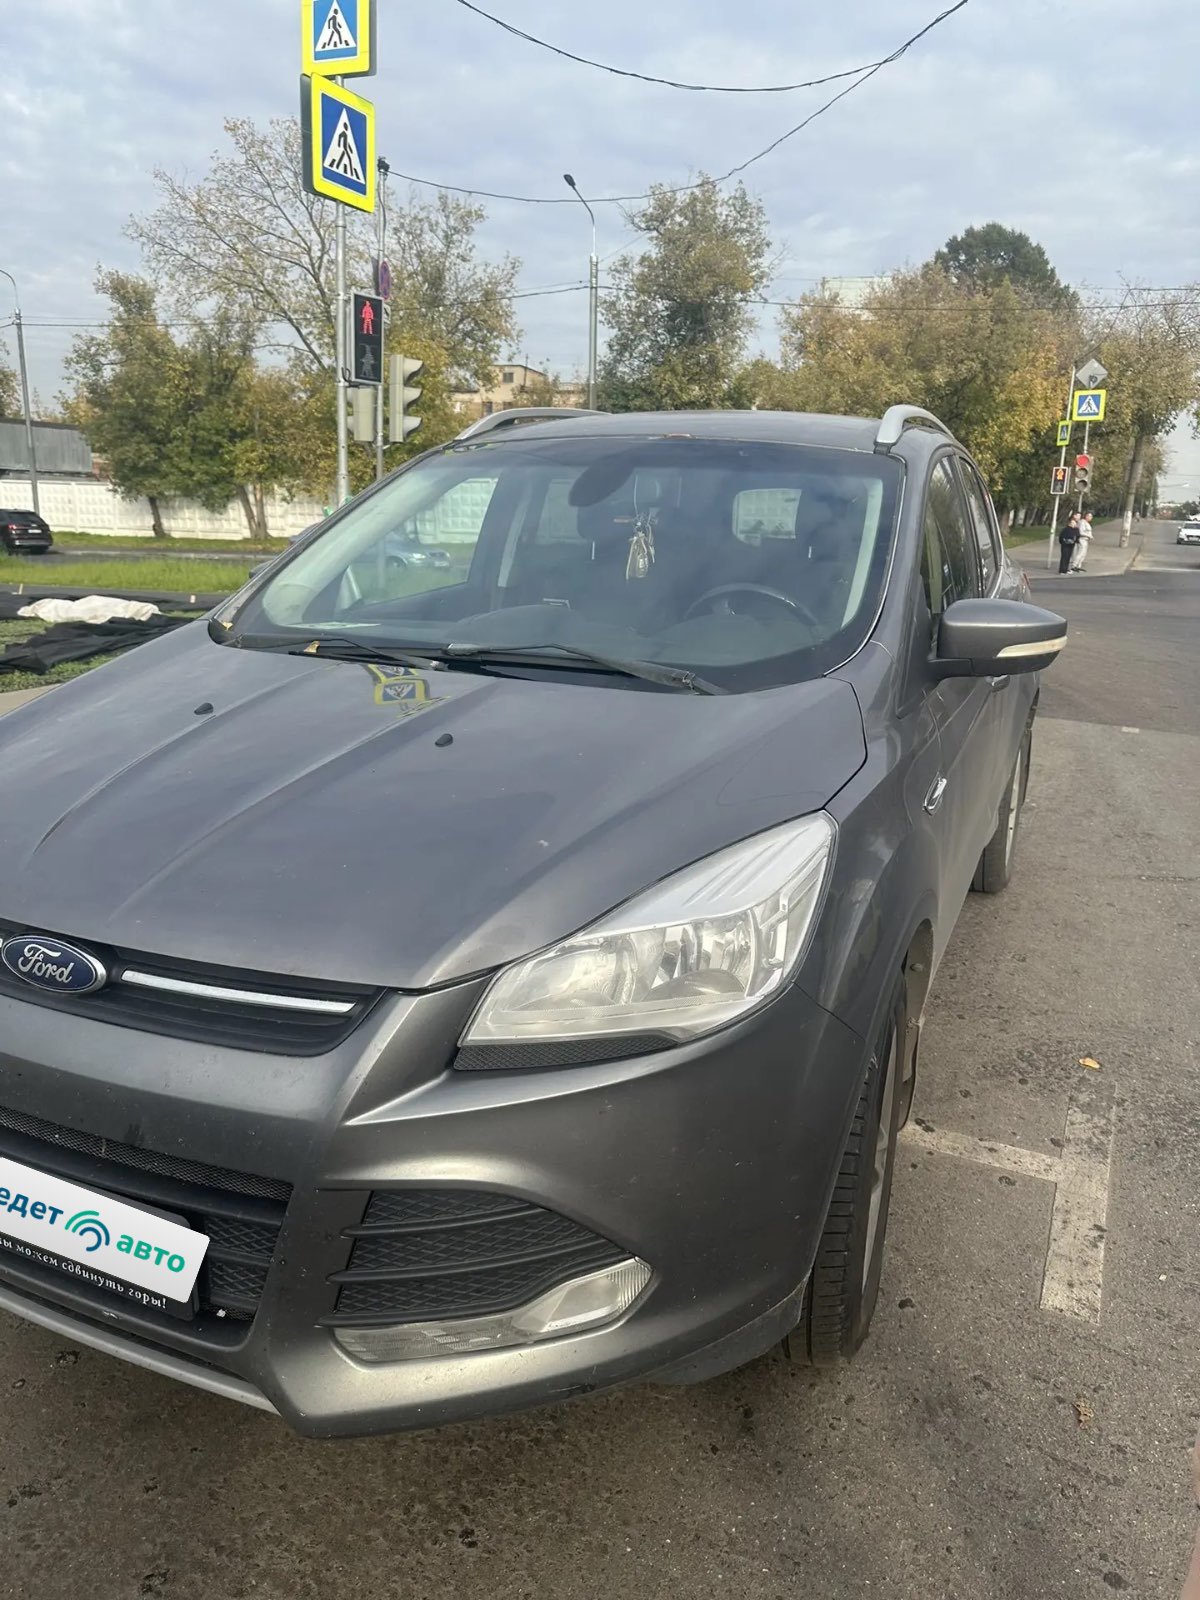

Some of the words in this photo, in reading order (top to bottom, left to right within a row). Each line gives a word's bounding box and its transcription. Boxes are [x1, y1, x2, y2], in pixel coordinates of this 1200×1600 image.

[18, 943, 75, 983] Ford
[0, 1238, 13, 1249] ы
[16, 1244, 58, 1266] можем
[62, 1261, 124, 1292] сдвинуть
[128, 1288, 166, 1309] горы!
